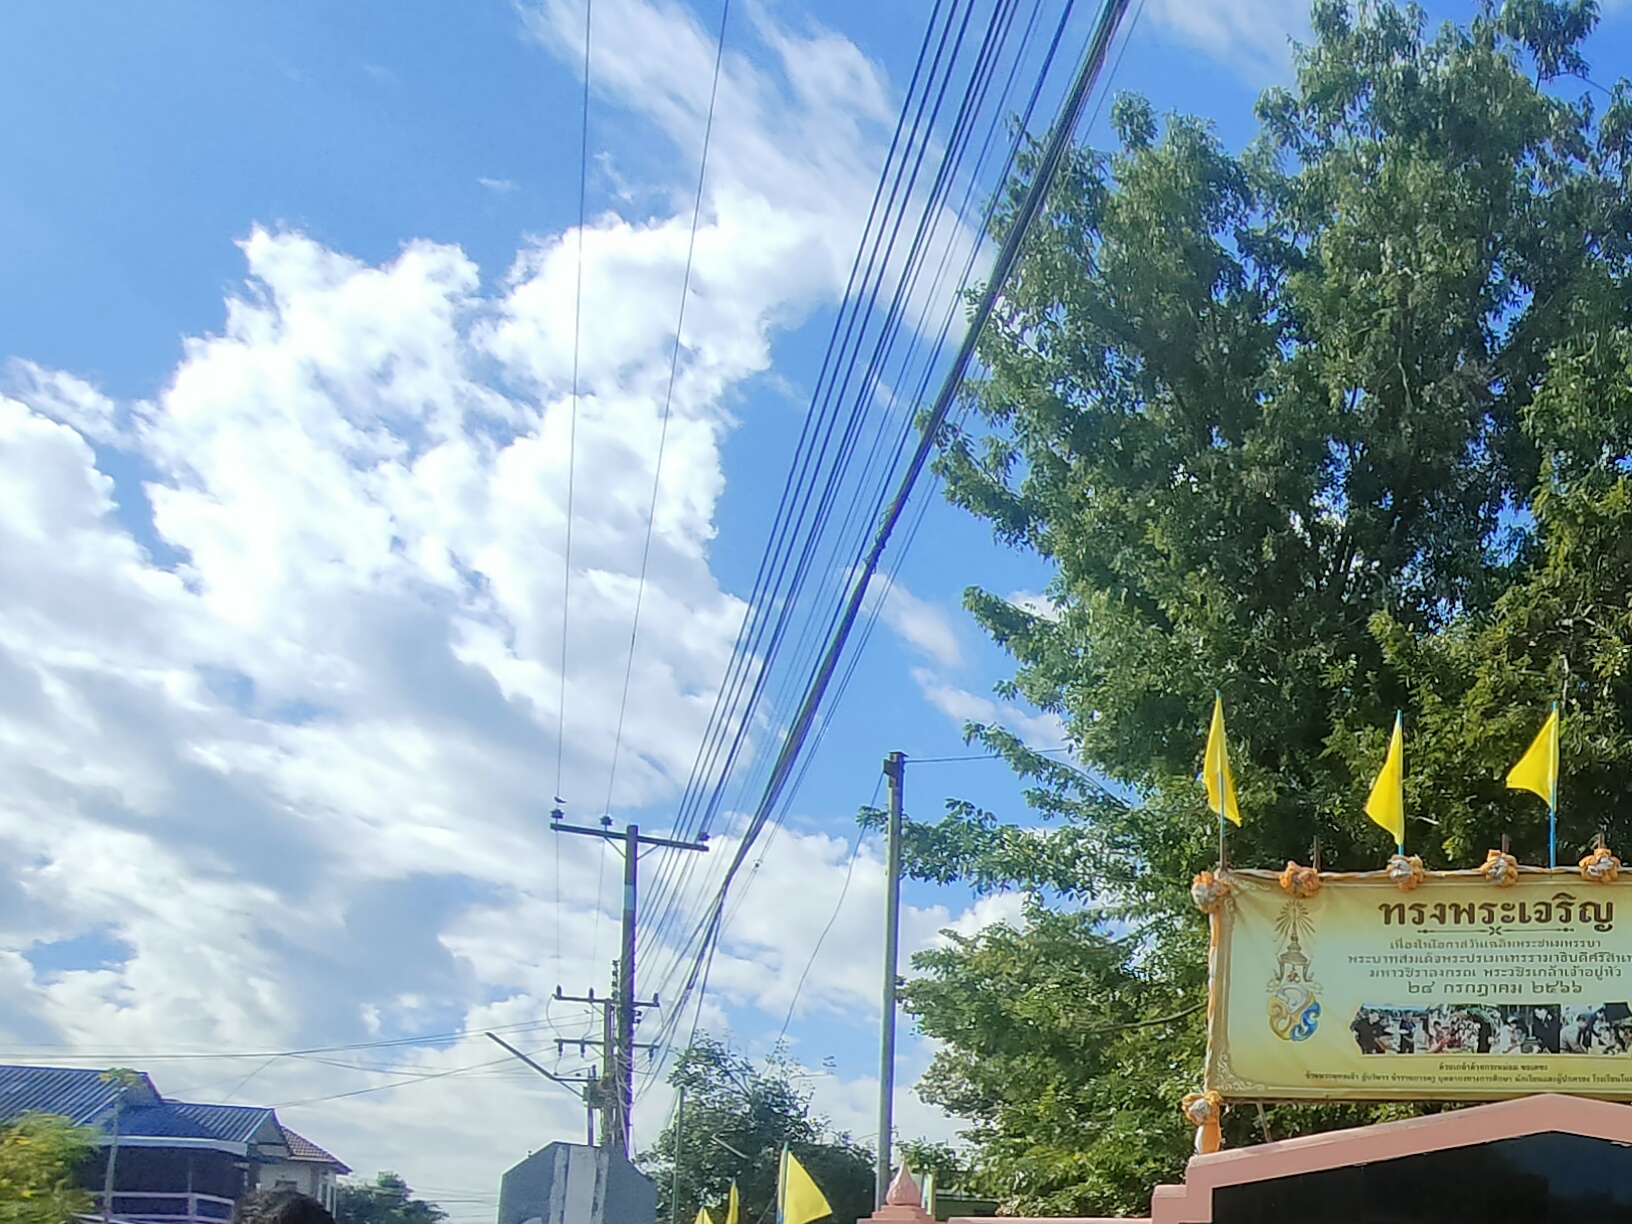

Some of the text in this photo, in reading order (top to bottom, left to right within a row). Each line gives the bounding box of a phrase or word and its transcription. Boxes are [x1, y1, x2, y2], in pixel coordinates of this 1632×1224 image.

[1377, 891, 1614, 932] ทรงพระเจริญ
[1444, 983, 1522, 997] กรกฎาคม
[1531, 980, 1583, 994] ๒๕๖๖
